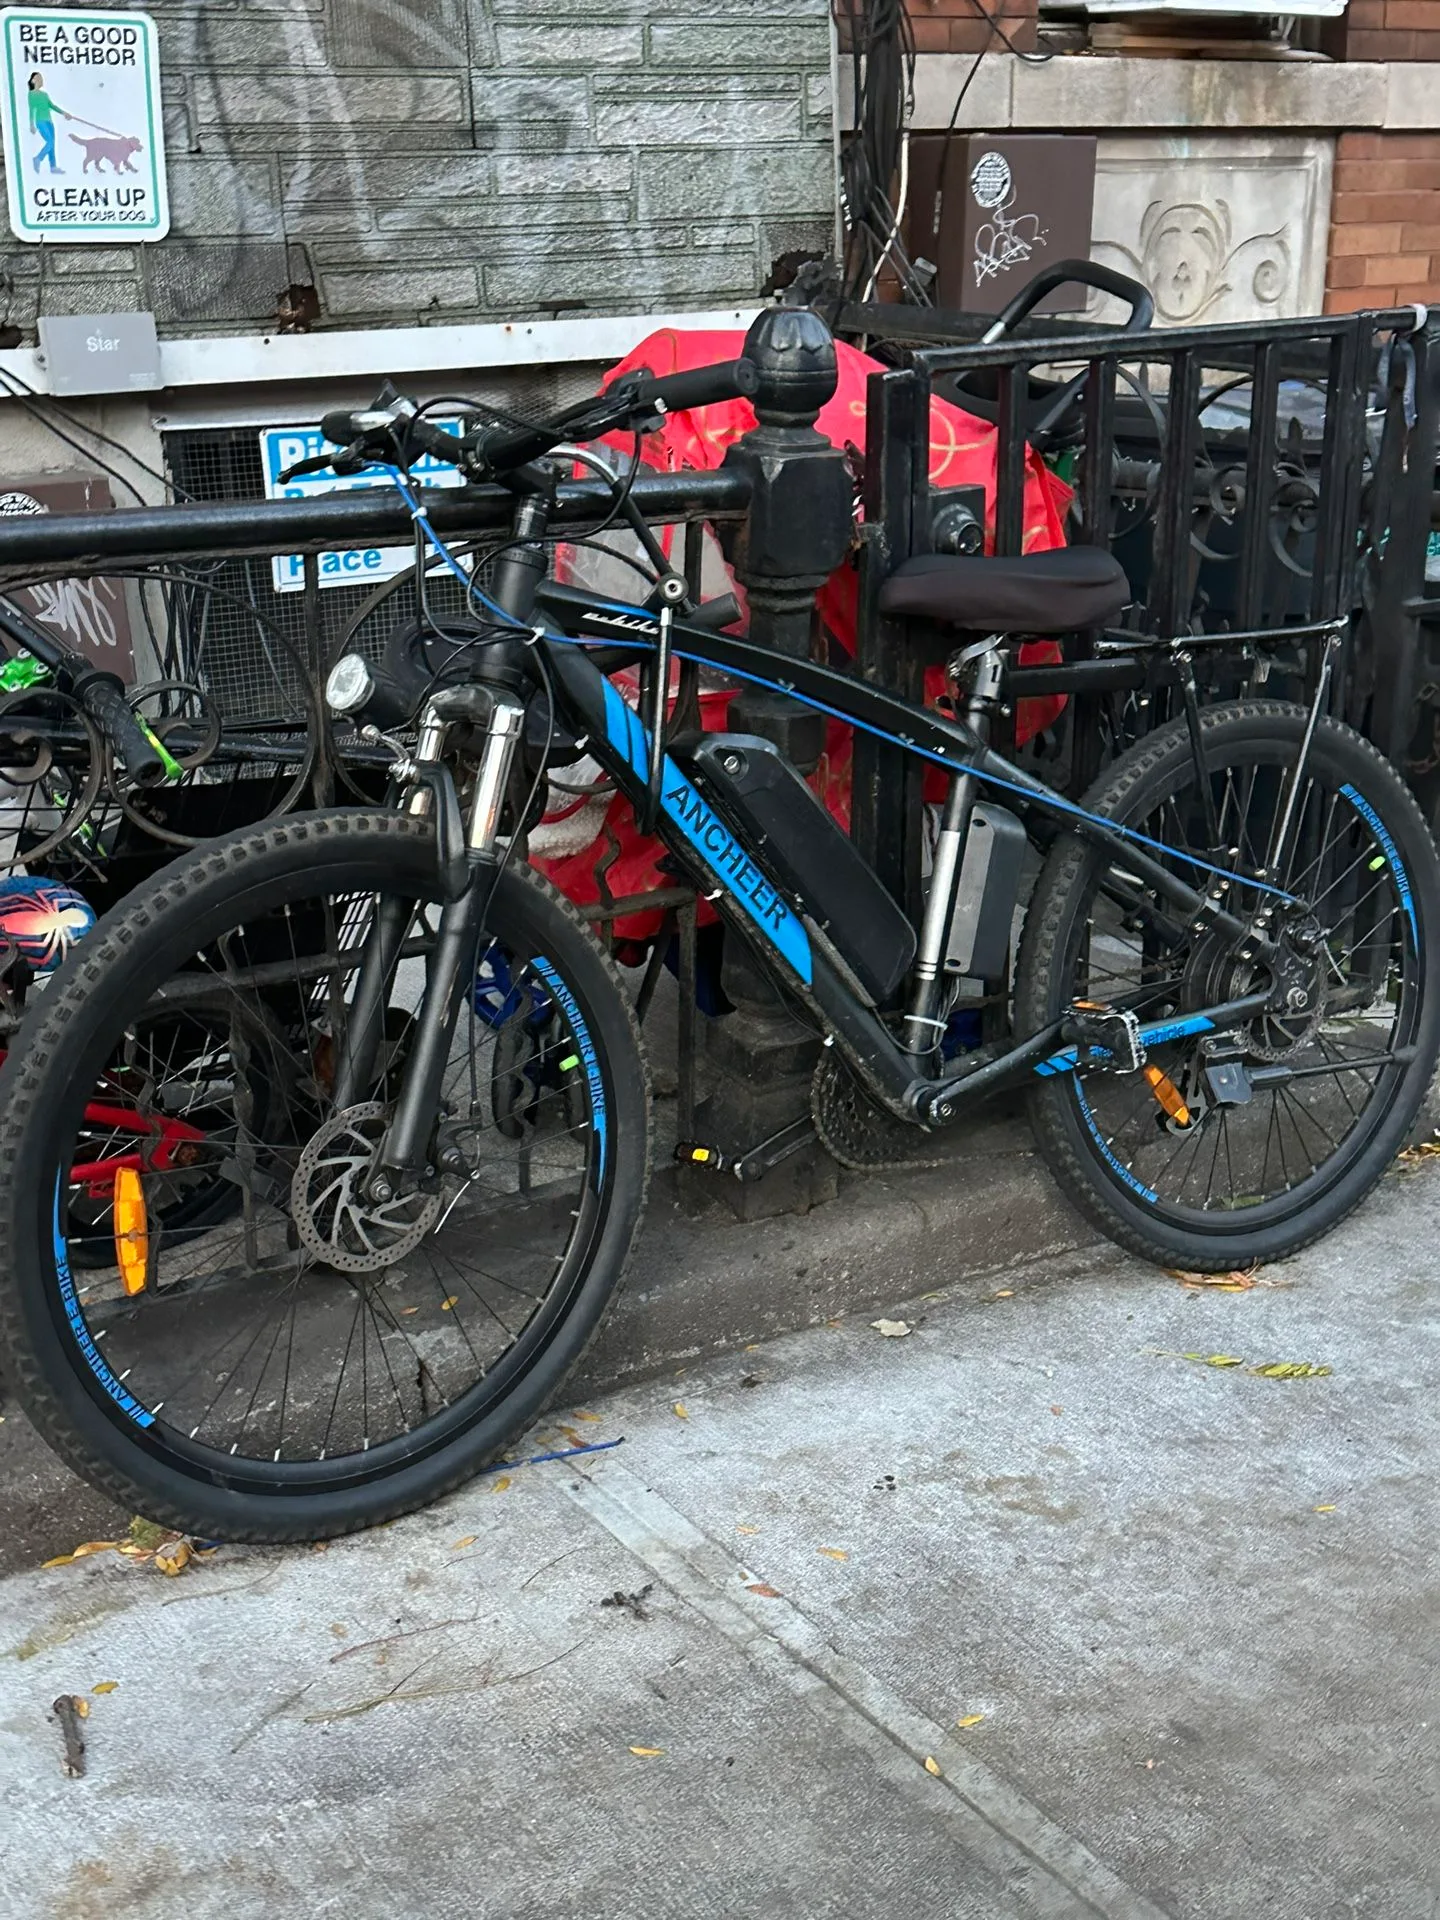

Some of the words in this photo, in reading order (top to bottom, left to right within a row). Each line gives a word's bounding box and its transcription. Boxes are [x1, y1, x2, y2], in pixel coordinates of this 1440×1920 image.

[20, 24, 47, 42] BE
[53, 25, 69, 43] A
[74, 26, 137, 45] GOOD
[24, 45, 136, 66] NEIGHBOR
[34, 188, 109, 207] CLEAN
[116, 188, 146, 207] UP
[36, 210, 77, 222] AFTER
[80, 210, 116, 222] YOUR
[119, 209, 146, 222] DOG
[86, 336, 120, 352] Star
[289, 548, 382, 576] Pace
[665, 784, 788, 931] ANCHEER
